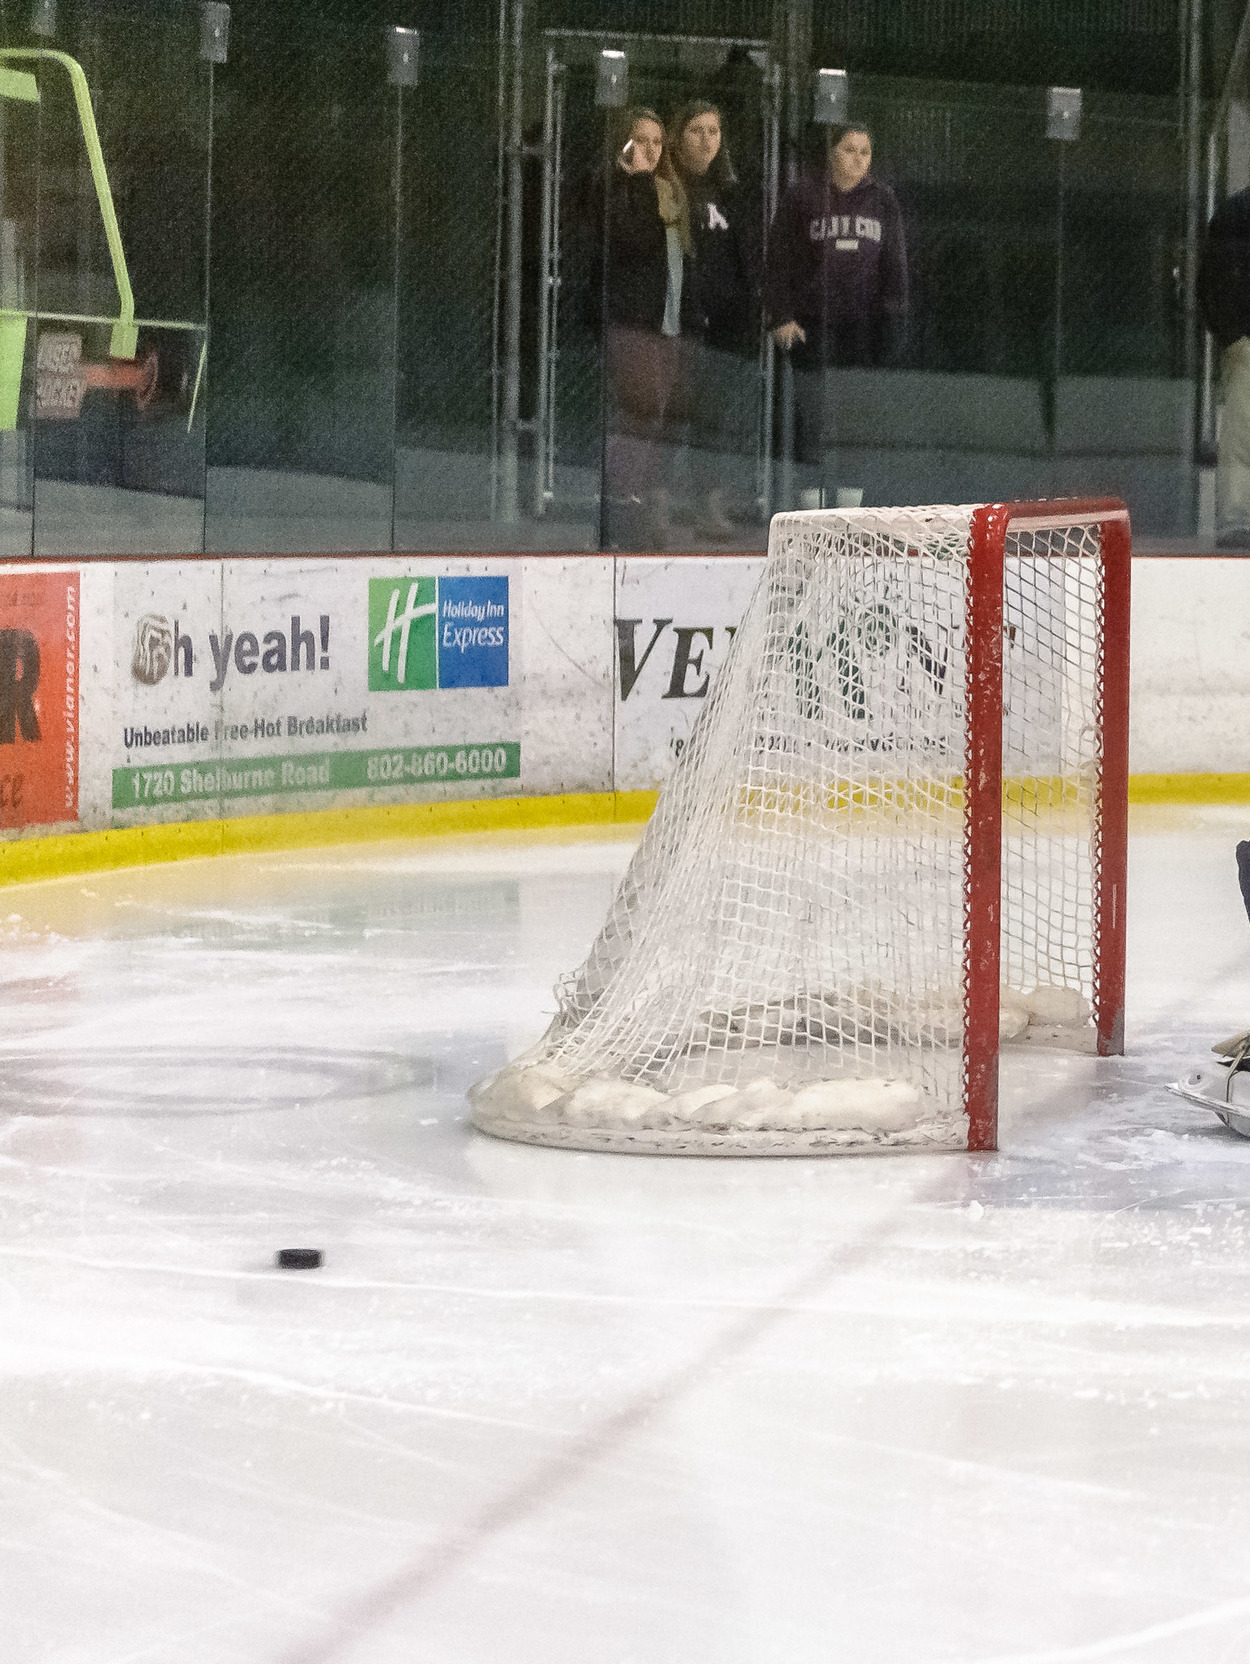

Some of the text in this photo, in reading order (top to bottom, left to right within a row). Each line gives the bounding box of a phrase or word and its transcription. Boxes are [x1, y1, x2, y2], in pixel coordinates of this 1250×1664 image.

[442, 598, 505, 623] Holiday Inn
[208, 614, 331, 692] yeah!
[442, 621, 505, 652] Express
[65, 585, 78, 809] www.vianor.com
[122, 721, 209, 749] Unbeatable
[287, 711, 368, 738] Breakfast
[131, 770, 175, 800] 1720
[180, 762, 277, 796] Shelburne
[281, 757, 330, 787] Road
